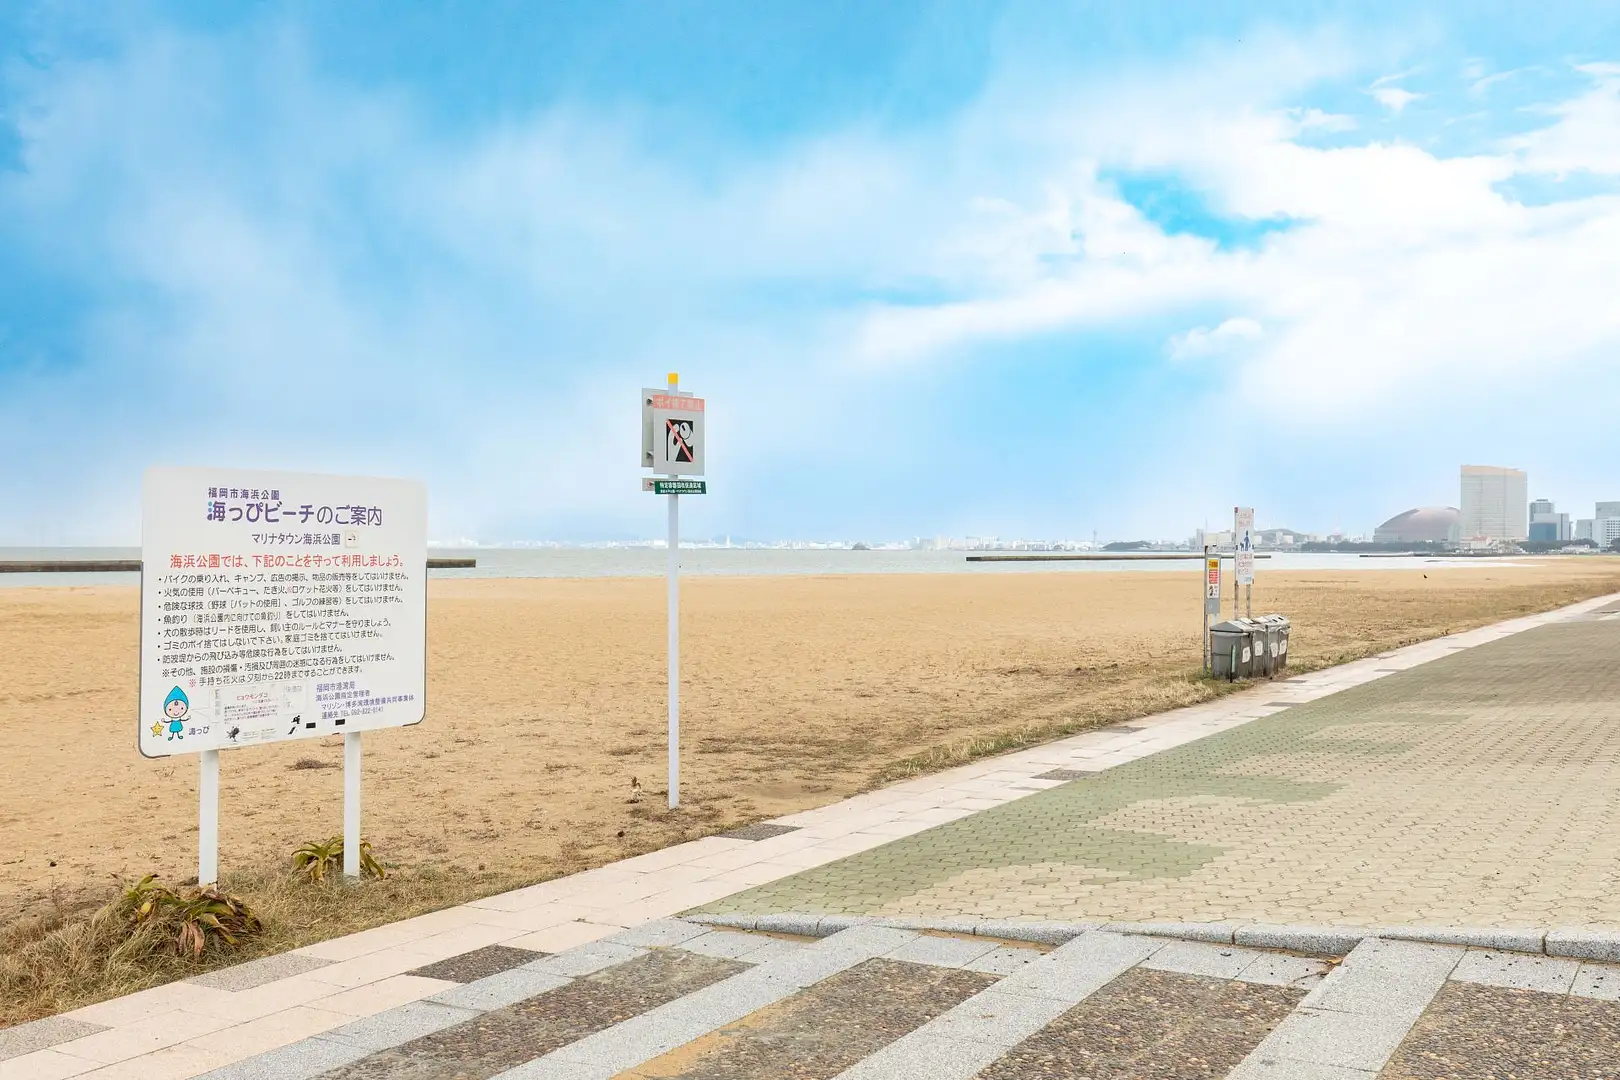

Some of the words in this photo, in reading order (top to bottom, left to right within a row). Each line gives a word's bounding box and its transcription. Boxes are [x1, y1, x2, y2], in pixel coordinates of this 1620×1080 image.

[208, 486, 280, 500] 福岡市海浜公園
[207, 500, 383, 526] 海っぴビーチのご案内
[251, 532, 341, 546] マリナタウン海浜公園
[170, 553, 405, 569] 海浜公園では、下記のことを守って利用しましょう。
